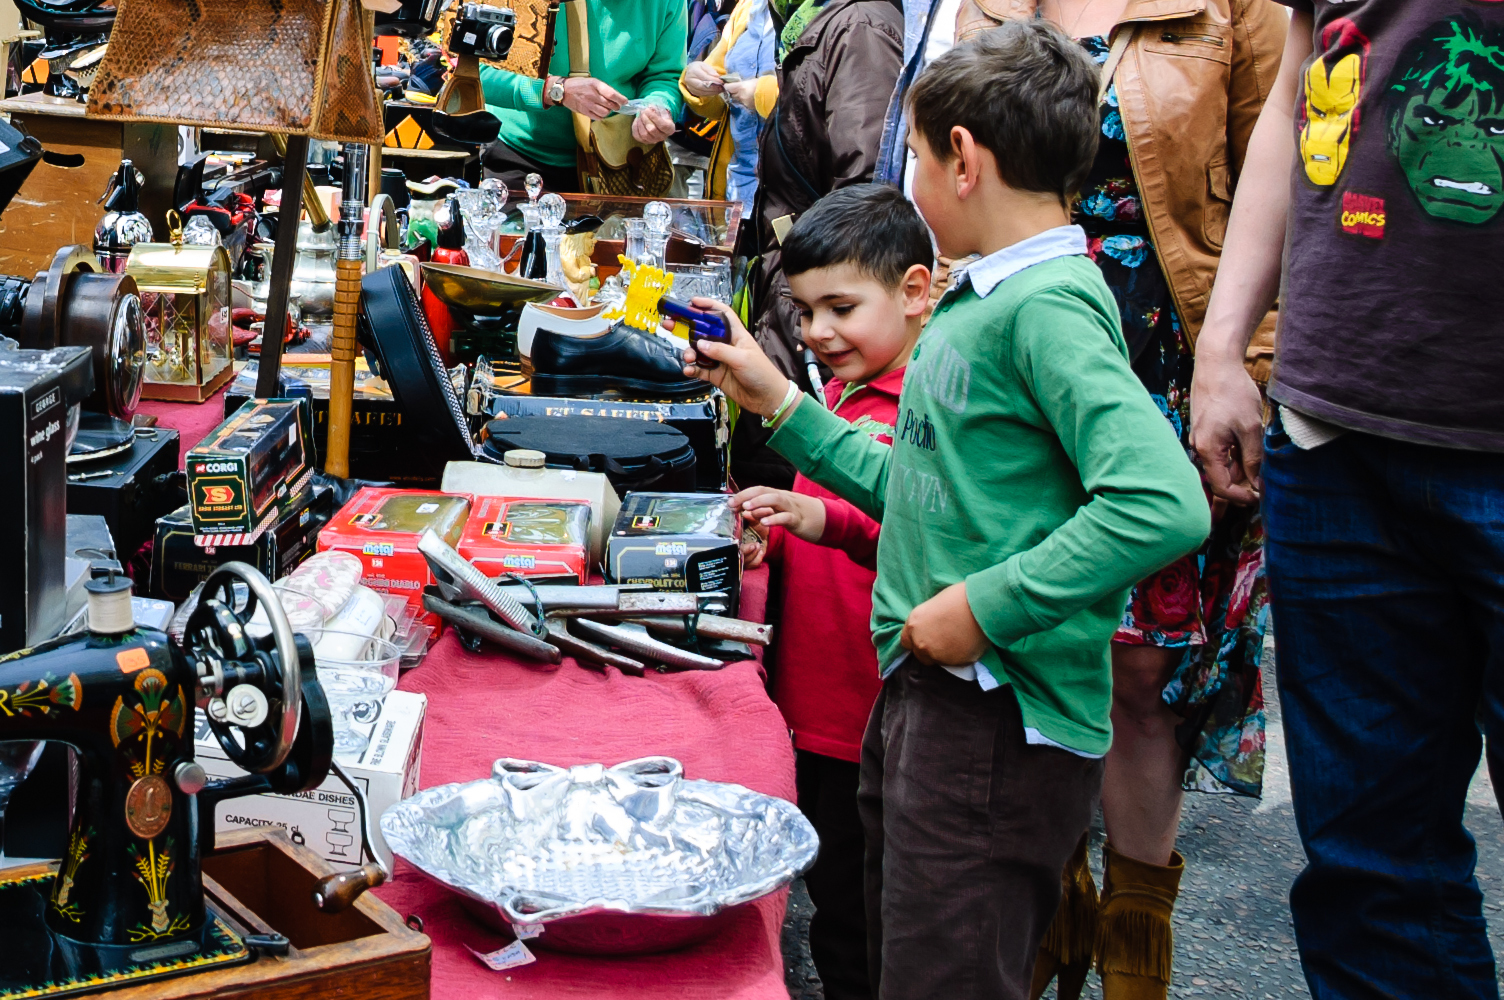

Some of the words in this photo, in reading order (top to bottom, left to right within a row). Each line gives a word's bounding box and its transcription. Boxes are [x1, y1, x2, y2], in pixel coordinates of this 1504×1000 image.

[1341, 211, 1386, 227] COMICS
[30, 430, 45, 447] wine
[45, 420, 61, 442] glass
[206, 462, 238, 473] CORGI
[363, 543, 394, 557] metal
[655, 543, 687, 556] metal
[503, 555, 535, 568] metal
[318, 793, 355, 806] DISHES
[225, 813, 273, 828] CAPACITY
